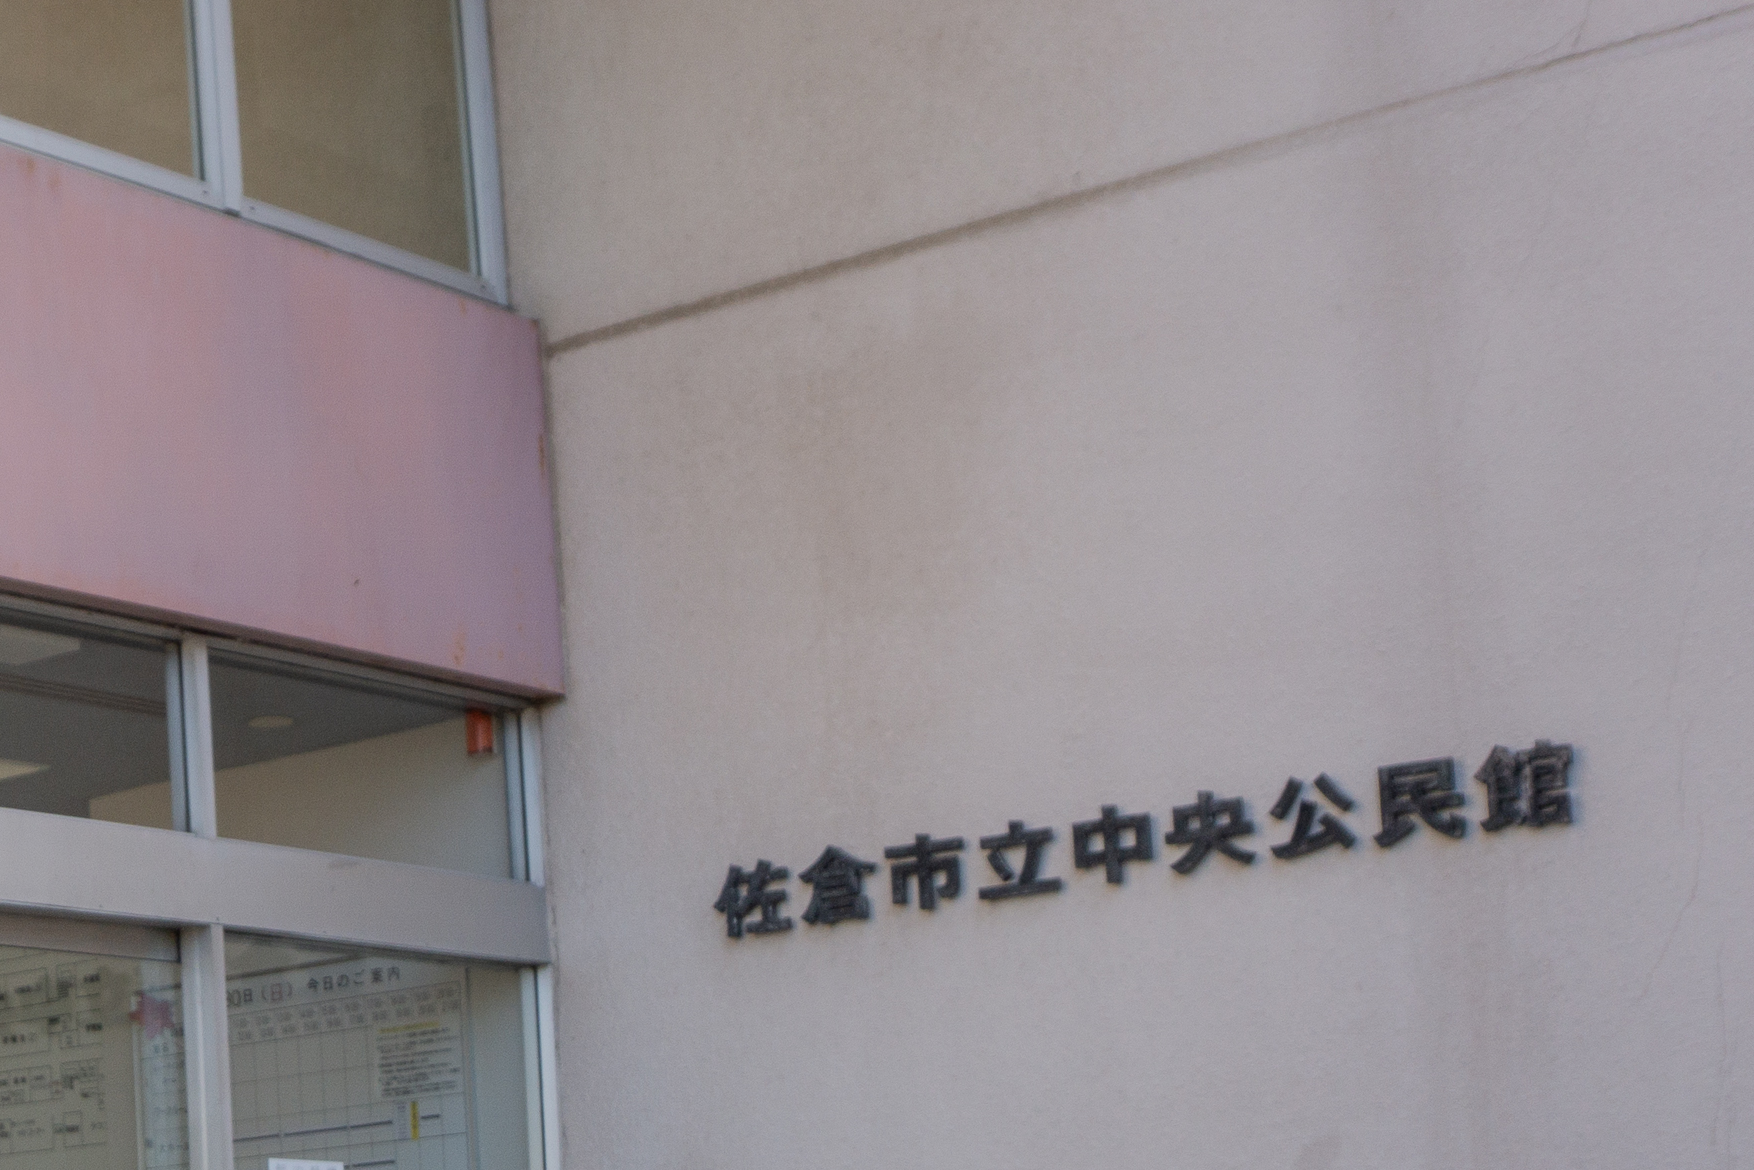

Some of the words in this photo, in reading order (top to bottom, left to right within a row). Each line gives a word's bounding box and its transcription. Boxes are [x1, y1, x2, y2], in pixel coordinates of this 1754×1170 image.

[713, 738, 1576, 939] 佐倉市立中央公民館
[307, 966, 401, 993] 今日のご案内
